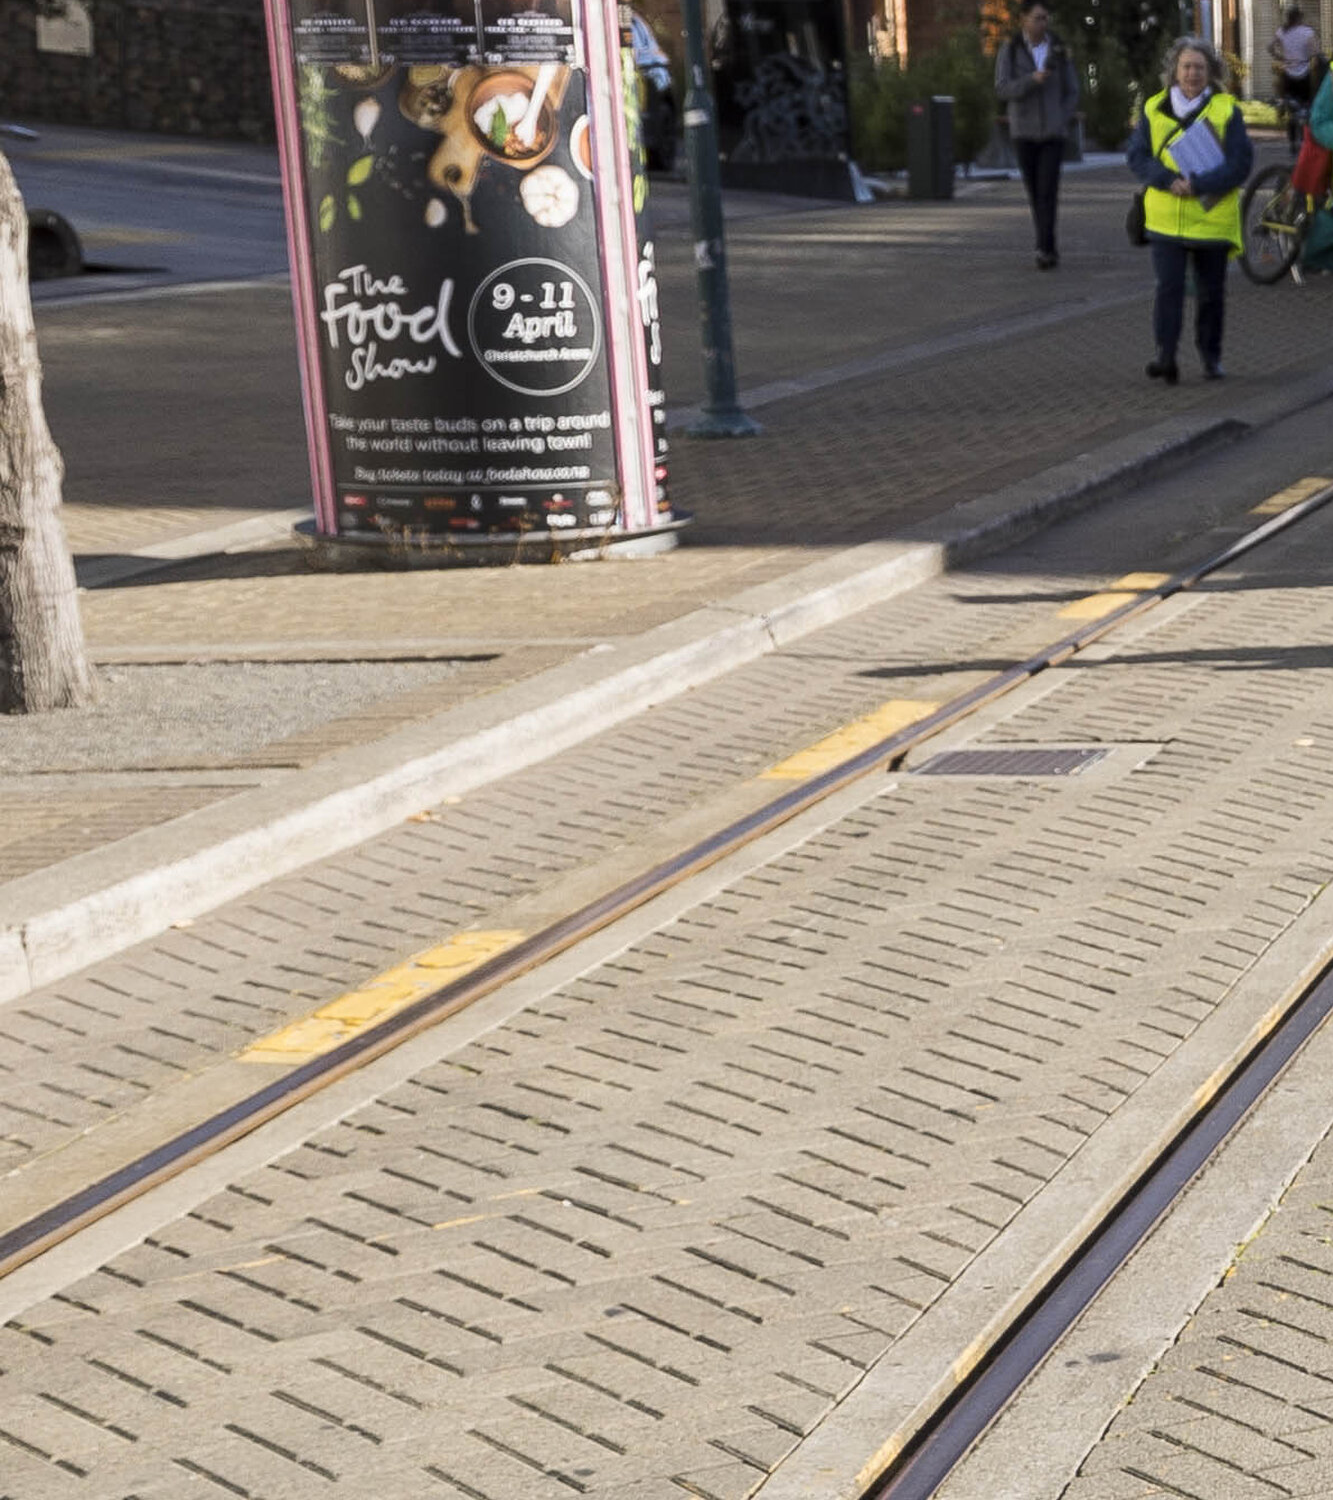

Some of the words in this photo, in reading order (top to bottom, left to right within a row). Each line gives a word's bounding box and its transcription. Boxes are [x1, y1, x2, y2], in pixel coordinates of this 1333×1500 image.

[338, 264, 408, 297] The
[492, 283, 516, 311] 9
[539, 282, 576, 309] 11
[502, 310, 578, 344] April
[345, 342, 437, 391] Show
[329, 413, 355, 430] Take
[357, 417, 388, 434] your
[391, 415, 431, 432] taste
[434, 415, 477, 432] buds
[481, 417, 507, 432] on
[508, 417, 522, 432] a
[524, 413, 556, 434] trip
[557, 410, 612, 429] around
[346, 436, 367, 451] the
[371, 435, 412, 451] world
[415, 435, 480, 451] without
[483, 435, 546, 454] leaving
[547, 432, 593, 450] town!
